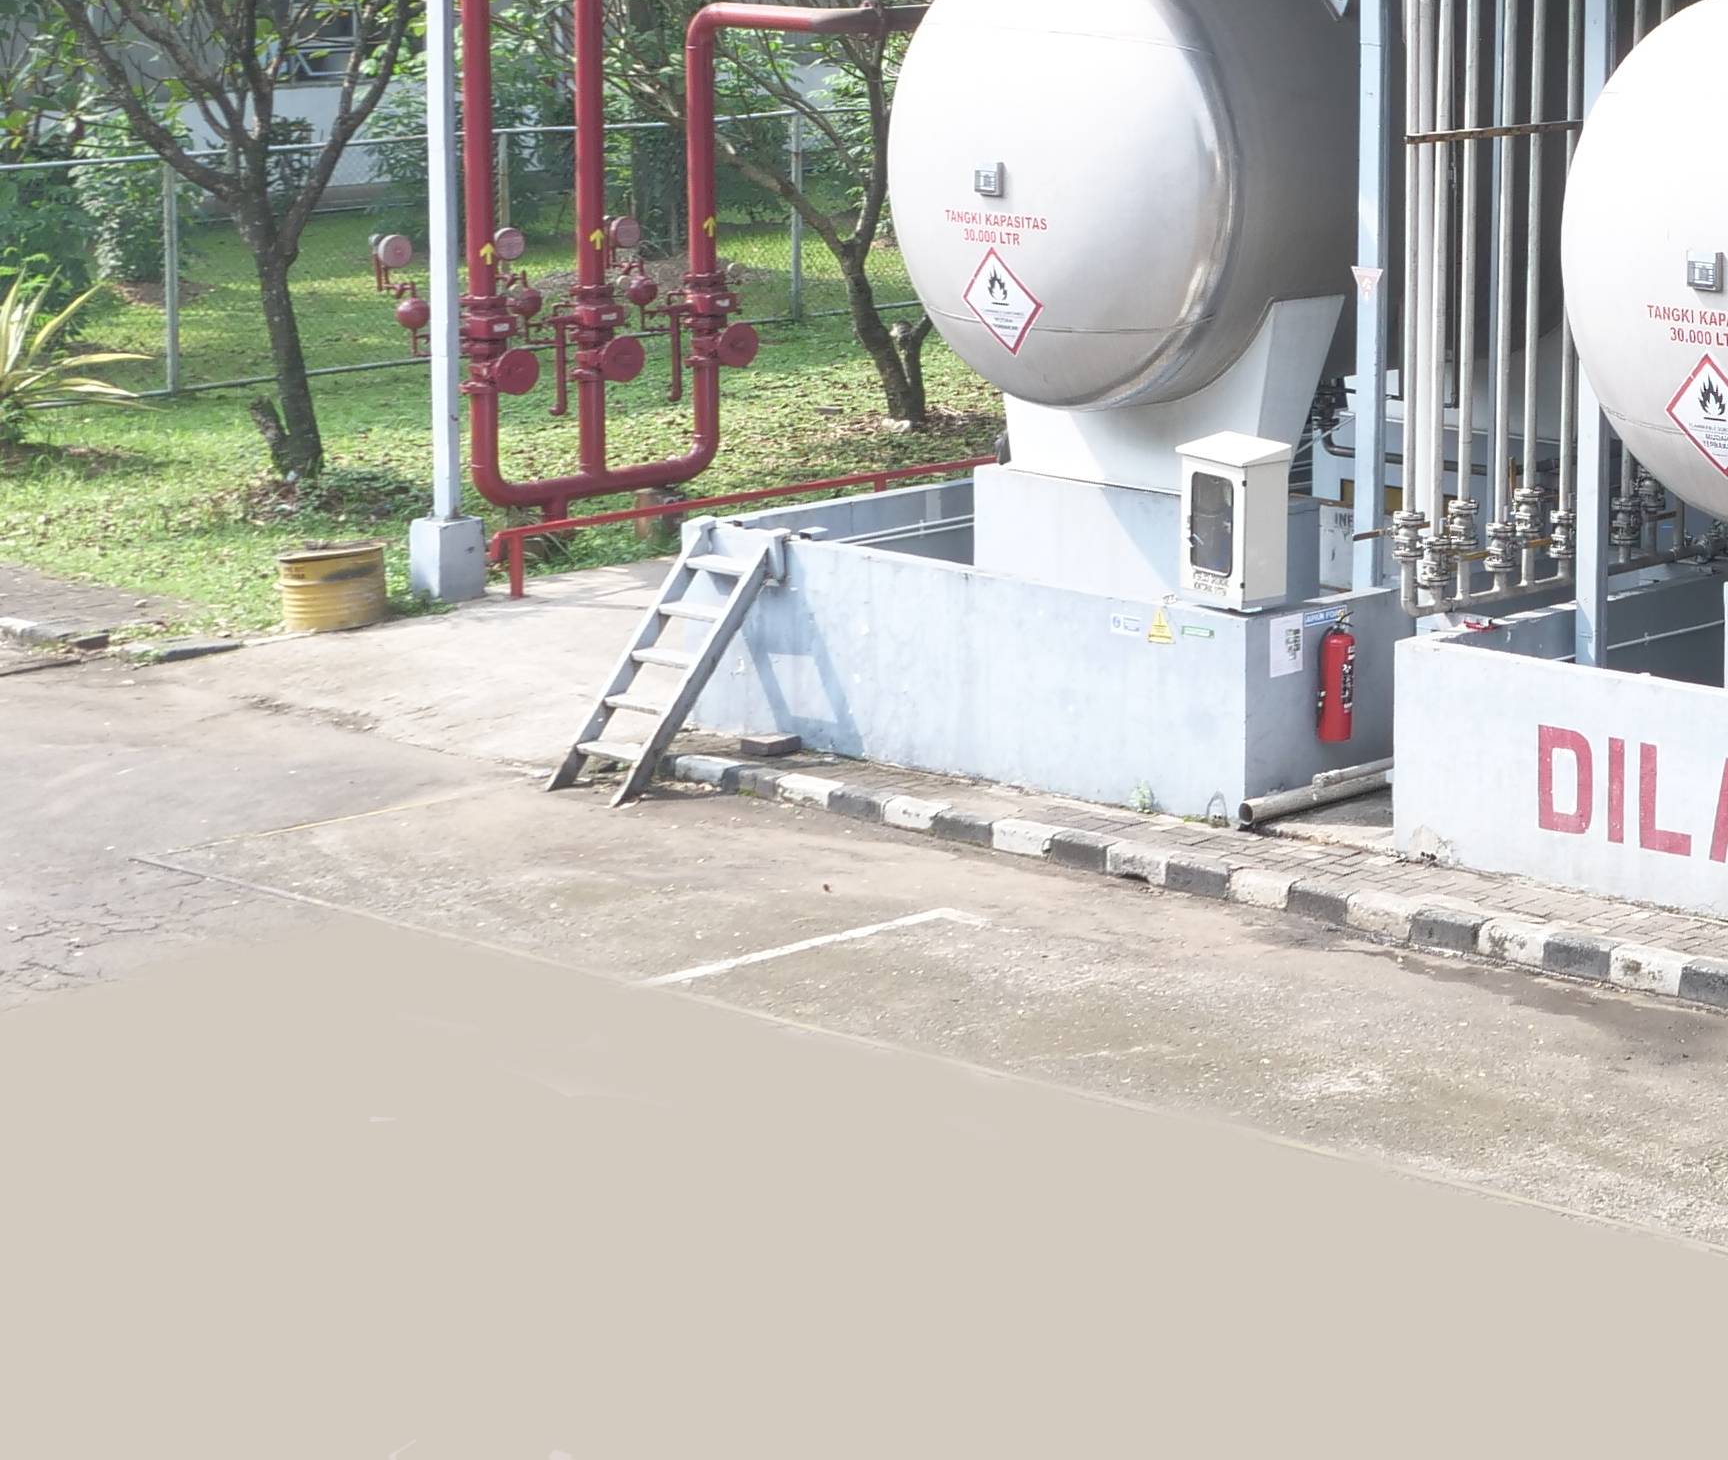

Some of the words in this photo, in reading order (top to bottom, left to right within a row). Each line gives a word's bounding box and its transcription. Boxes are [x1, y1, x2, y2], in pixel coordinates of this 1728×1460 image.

[945, 209, 982, 226] TANGKI
[985, 213, 1048, 230] KAPASITAS
[1000, 233, 1021, 246] LTR
[1647, 304, 1694, 324] TANGKI
[1670, 327, 1713, 346] 30.000
